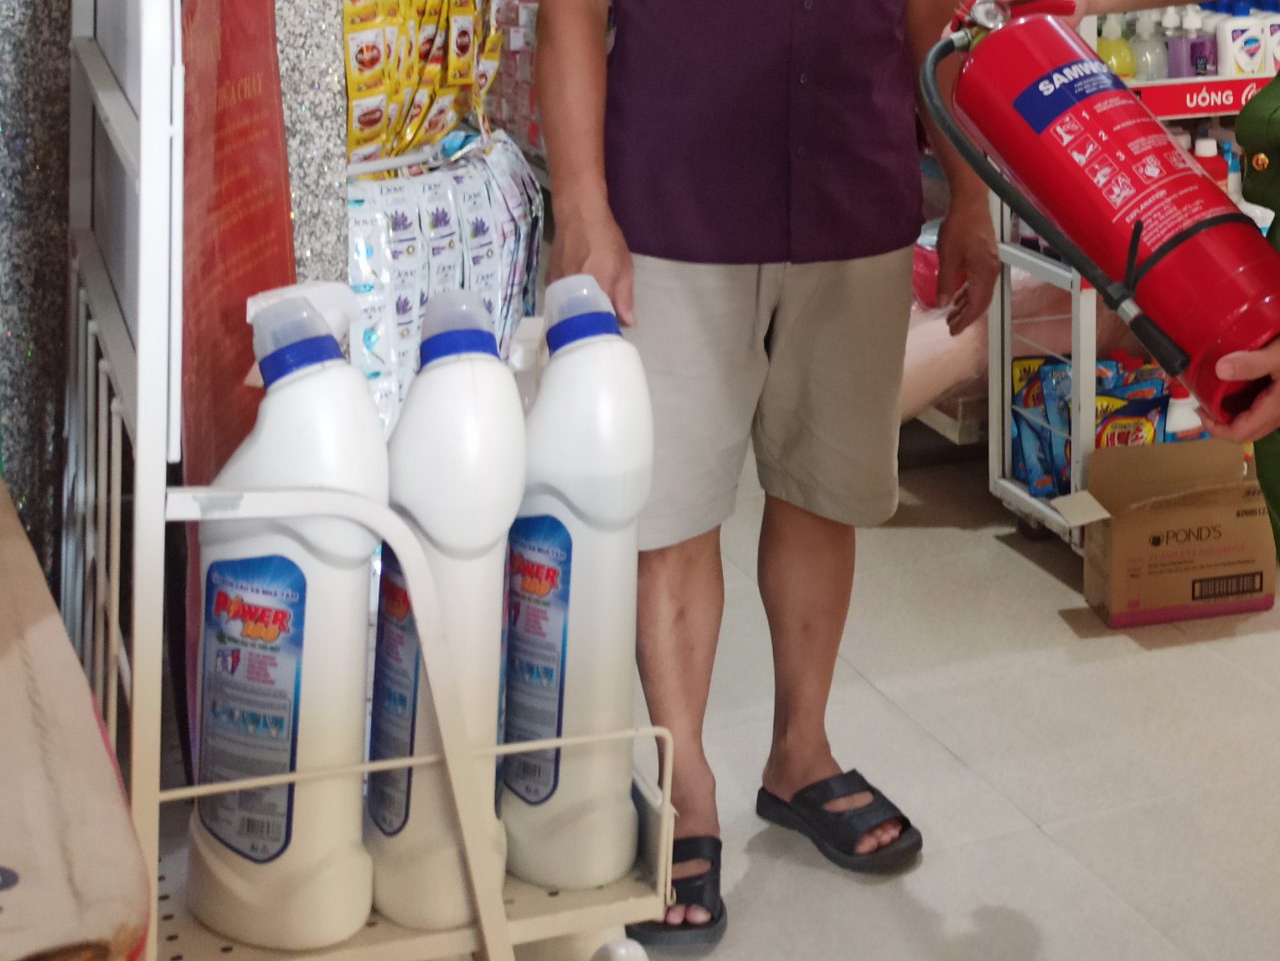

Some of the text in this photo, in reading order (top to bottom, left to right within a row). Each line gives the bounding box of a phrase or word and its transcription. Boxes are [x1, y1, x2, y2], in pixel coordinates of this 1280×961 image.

[1099, 130, 1108, 142] 2
[1116, 150, 1126, 161] 3
[1166, 523, 1222, 546] POND'S
